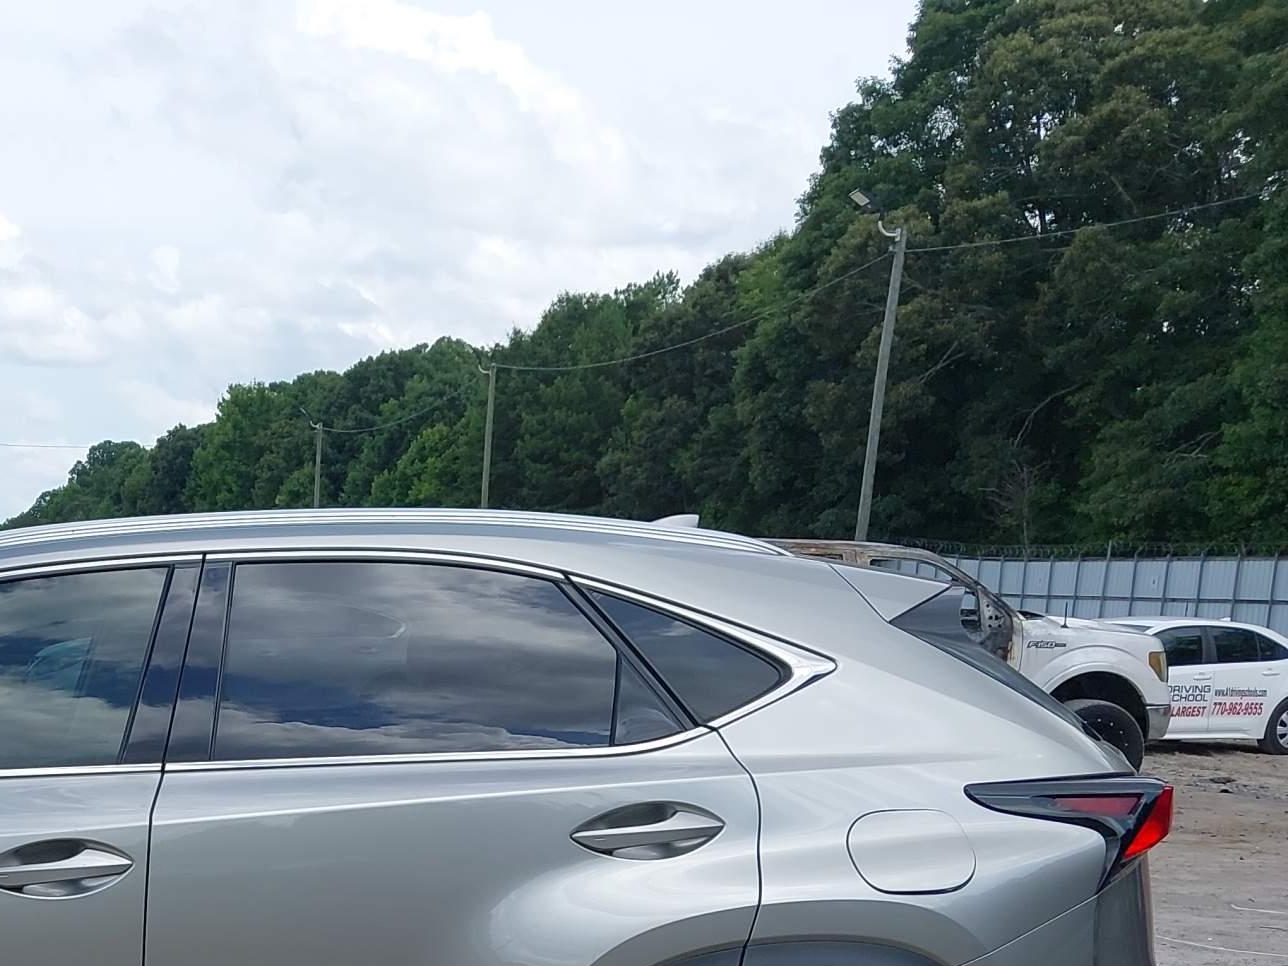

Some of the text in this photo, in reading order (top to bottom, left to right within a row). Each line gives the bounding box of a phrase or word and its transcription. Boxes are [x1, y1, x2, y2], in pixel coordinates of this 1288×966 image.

[1171, 693, 1208, 702] CHOOL
[1170, 706, 1207, 717] LARGEST
[1212, 702, 1263, 716] 770-962-9555
